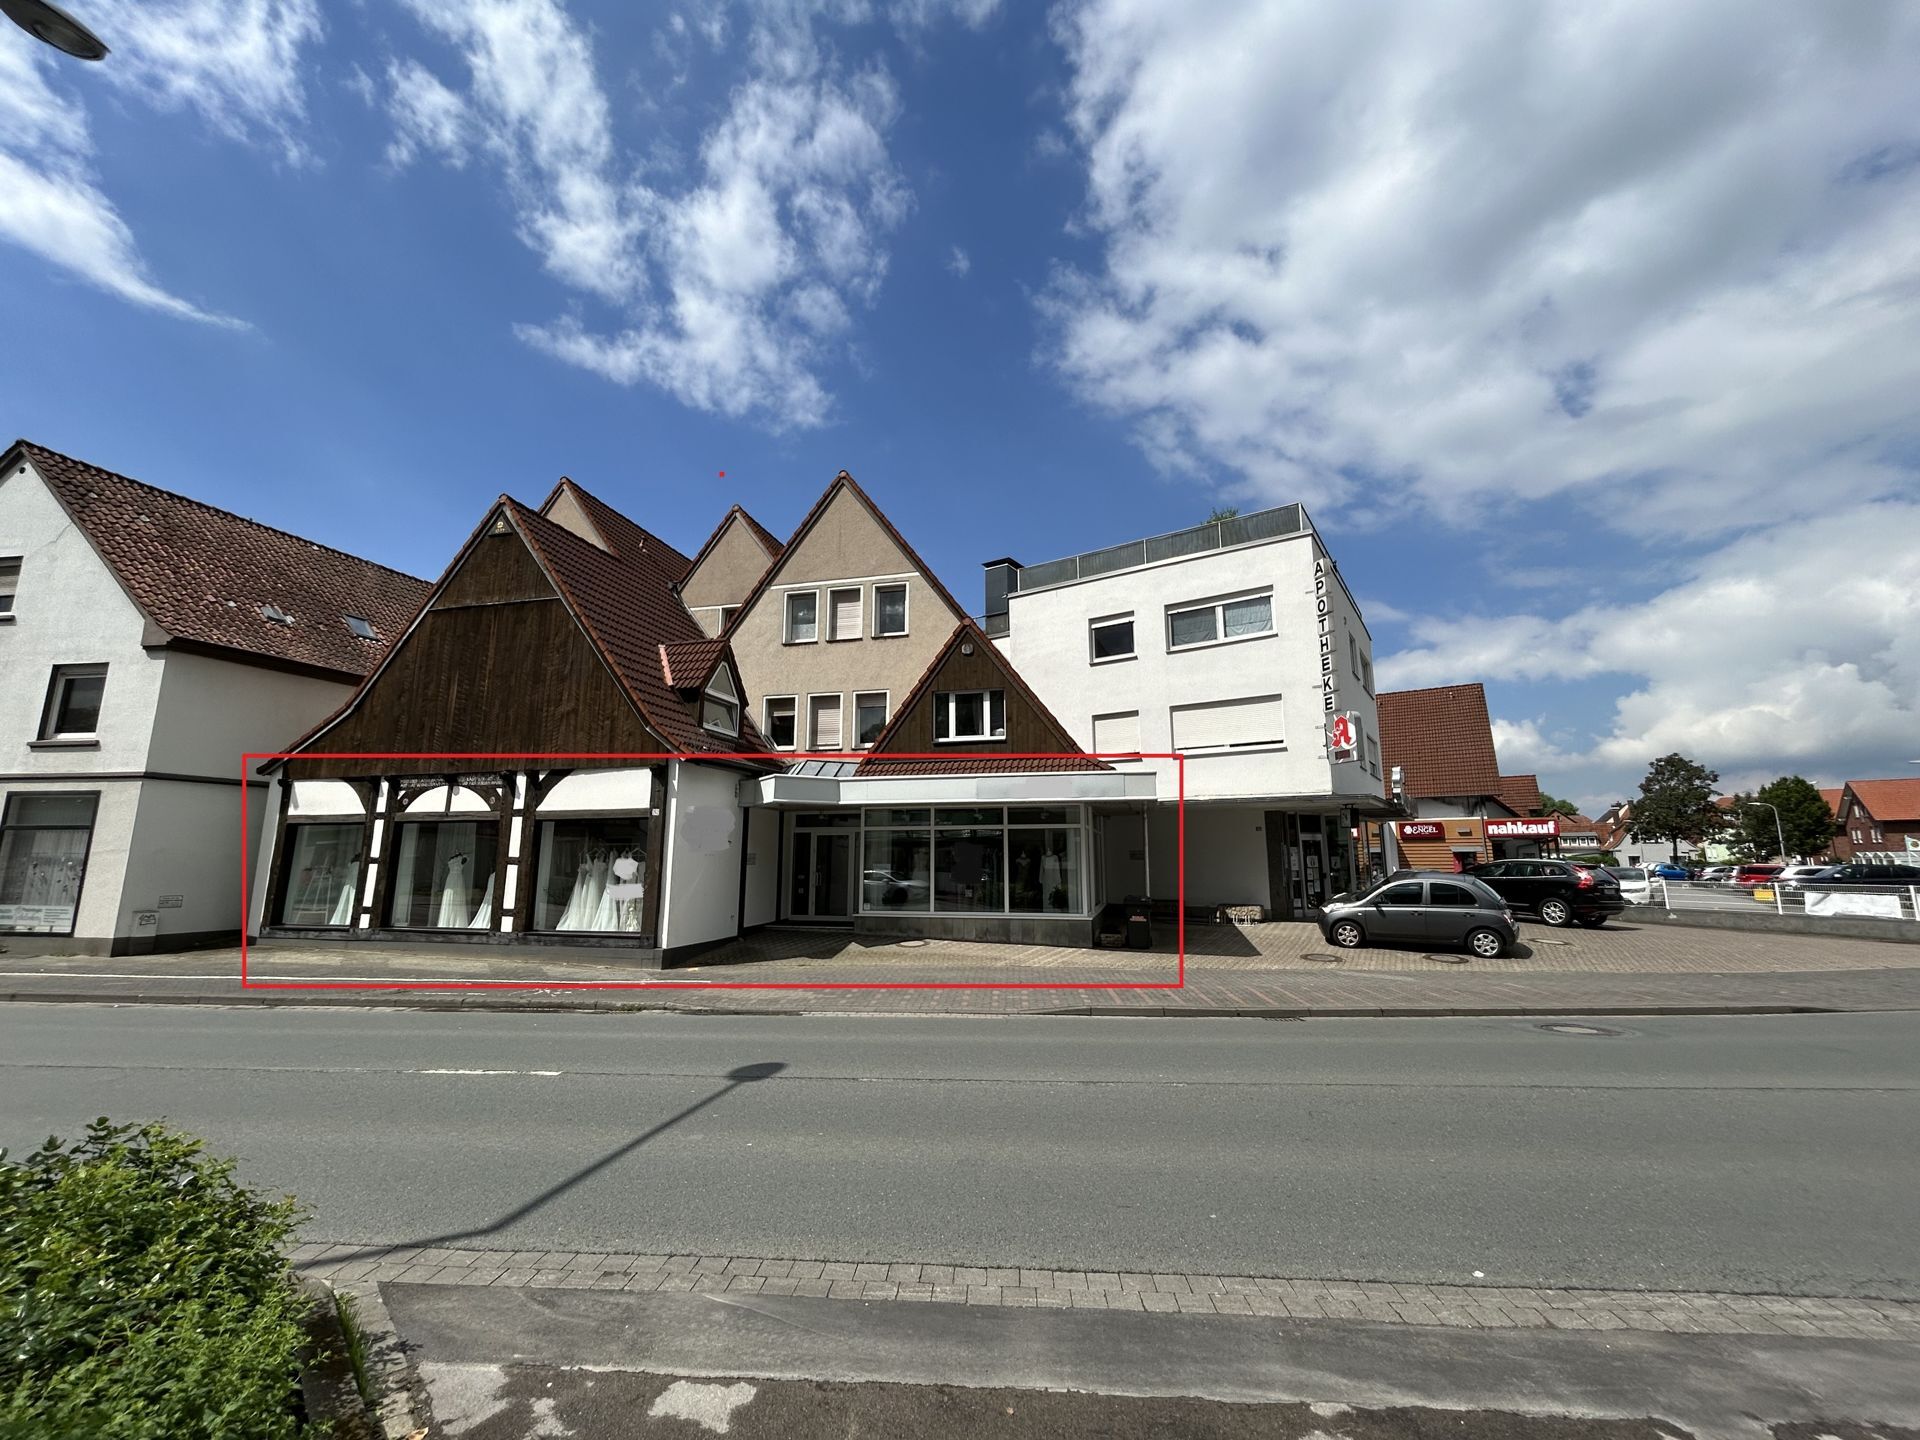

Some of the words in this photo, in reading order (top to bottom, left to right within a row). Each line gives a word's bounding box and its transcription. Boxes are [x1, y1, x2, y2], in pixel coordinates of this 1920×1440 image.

[1314, 561, 1334, 711] APOTHEKE
[1412, 826, 1438, 834] ENGEL
[1487, 821, 1555, 834] nahkauf
